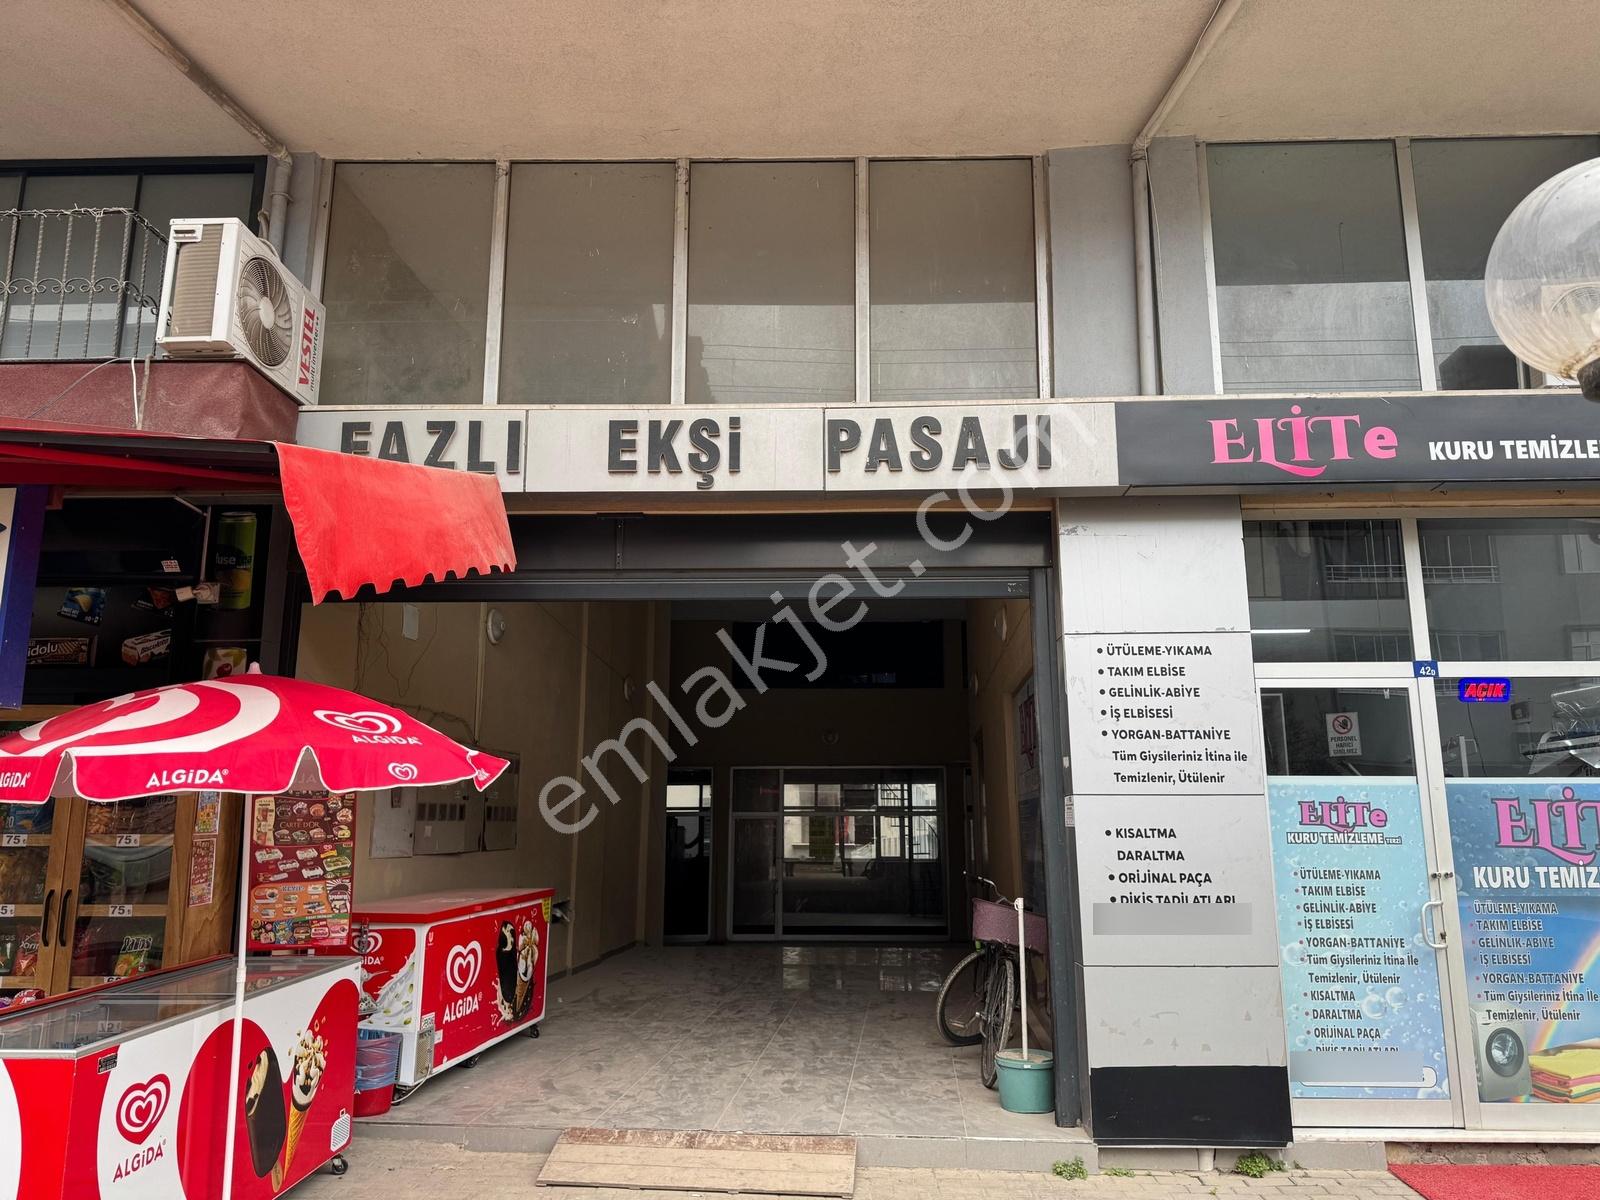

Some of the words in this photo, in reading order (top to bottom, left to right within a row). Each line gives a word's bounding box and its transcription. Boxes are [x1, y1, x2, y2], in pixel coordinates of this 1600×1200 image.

[299, 308, 316, 385] VESTEL
[826, 414, 1052, 473] PASAJI
[1428, 440, 1494, 461] KURU
[1106, 643, 1212, 656] ÜTÜLEME-YIKAMA
[1107, 666, 1144, 677] TAKIM
[1147, 664, 1186, 677] ELBİSE
[1109, 684, 1201, 698] GELİNLİK-ABİYE
[1464, 683, 1506, 702] AÇIK
[1110, 705, 1121, 721] İŞ
[1123, 705, 1173, 719] ELBİSESİ
[1111, 726, 1231, 740] YORGAN-BATTANİYE
[1112, 751, 1137, 761] Tüm
[1139, 751, 1202, 764] Giysileriniz
[1205, 748, 1232, 761] İtina
[1114, 772, 1176, 785] Temizlenir,
[1178, 770, 1225, 783] Ütülenir
[1115, 828, 1177, 839] KISALTMA
[1287, 832, 1319, 844] KURU
[1320, 831, 1384, 844] TEMİZLEME
[1117, 850, 1185, 861] DARALTMA
[1118, 869, 1177, 883] ORİJİNAL
[1179, 872, 1212, 887] PAÇA
[1300, 866, 1381, 880] ÜTÜLEME-YIKAMA
[1472, 866, 1530, 889] KURU
[1302, 886, 1333, 896] TAKIM
[1336, 883, 1366, 896] ELBİSE
[1303, 900, 1377, 913] GELİNLİK-ABİYE
[1474, 900, 1558, 914] ÜTÜLEME-YIKAMA
[1304, 916, 1313, 932] İŞ
[1315, 916, 1354, 930] ELBİSESİ
[1476, 920, 1509, 931] TAKIM
[1511, 918, 1543, 931] ELBİSE
[1306, 935, 1405, 948] YORGAN-BATTANİYE
[1478, 934, 1554, 948] GELİNLİK-ABİYE
[1307, 954, 1328, 965] Tüm
[1330, 954, 1381, 968] Giysileriniz
[1383, 952, 1405, 965] İtina
[1479, 951, 1489, 967] İŞ
[1491, 951, 1531, 965] ELBİSESİ
[1308, 972, 1360, 985] Temizlenir,
[1362, 970, 1401, 984] Ütülenir
[1482, 970, 1584, 984] YORGAN-BATTANİYE
[1310, 990, 1356, 1001] KISALTMA
[1484, 990, 1506, 1001] Tüm
[1507, 990, 1560, 1004] Giysileriniz
[1562, 988, 1584, 1001] İtina
[1312, 1009, 1362, 1020] DARALTMA
[1486, 1009, 1540, 1022] Temizlenir,
[1541, 1007, 1581, 1020] Ütülenir
[1314, 1025, 1355, 1039] ORİJİNAL
[1357, 1028, 1381, 1041] PAÇA
